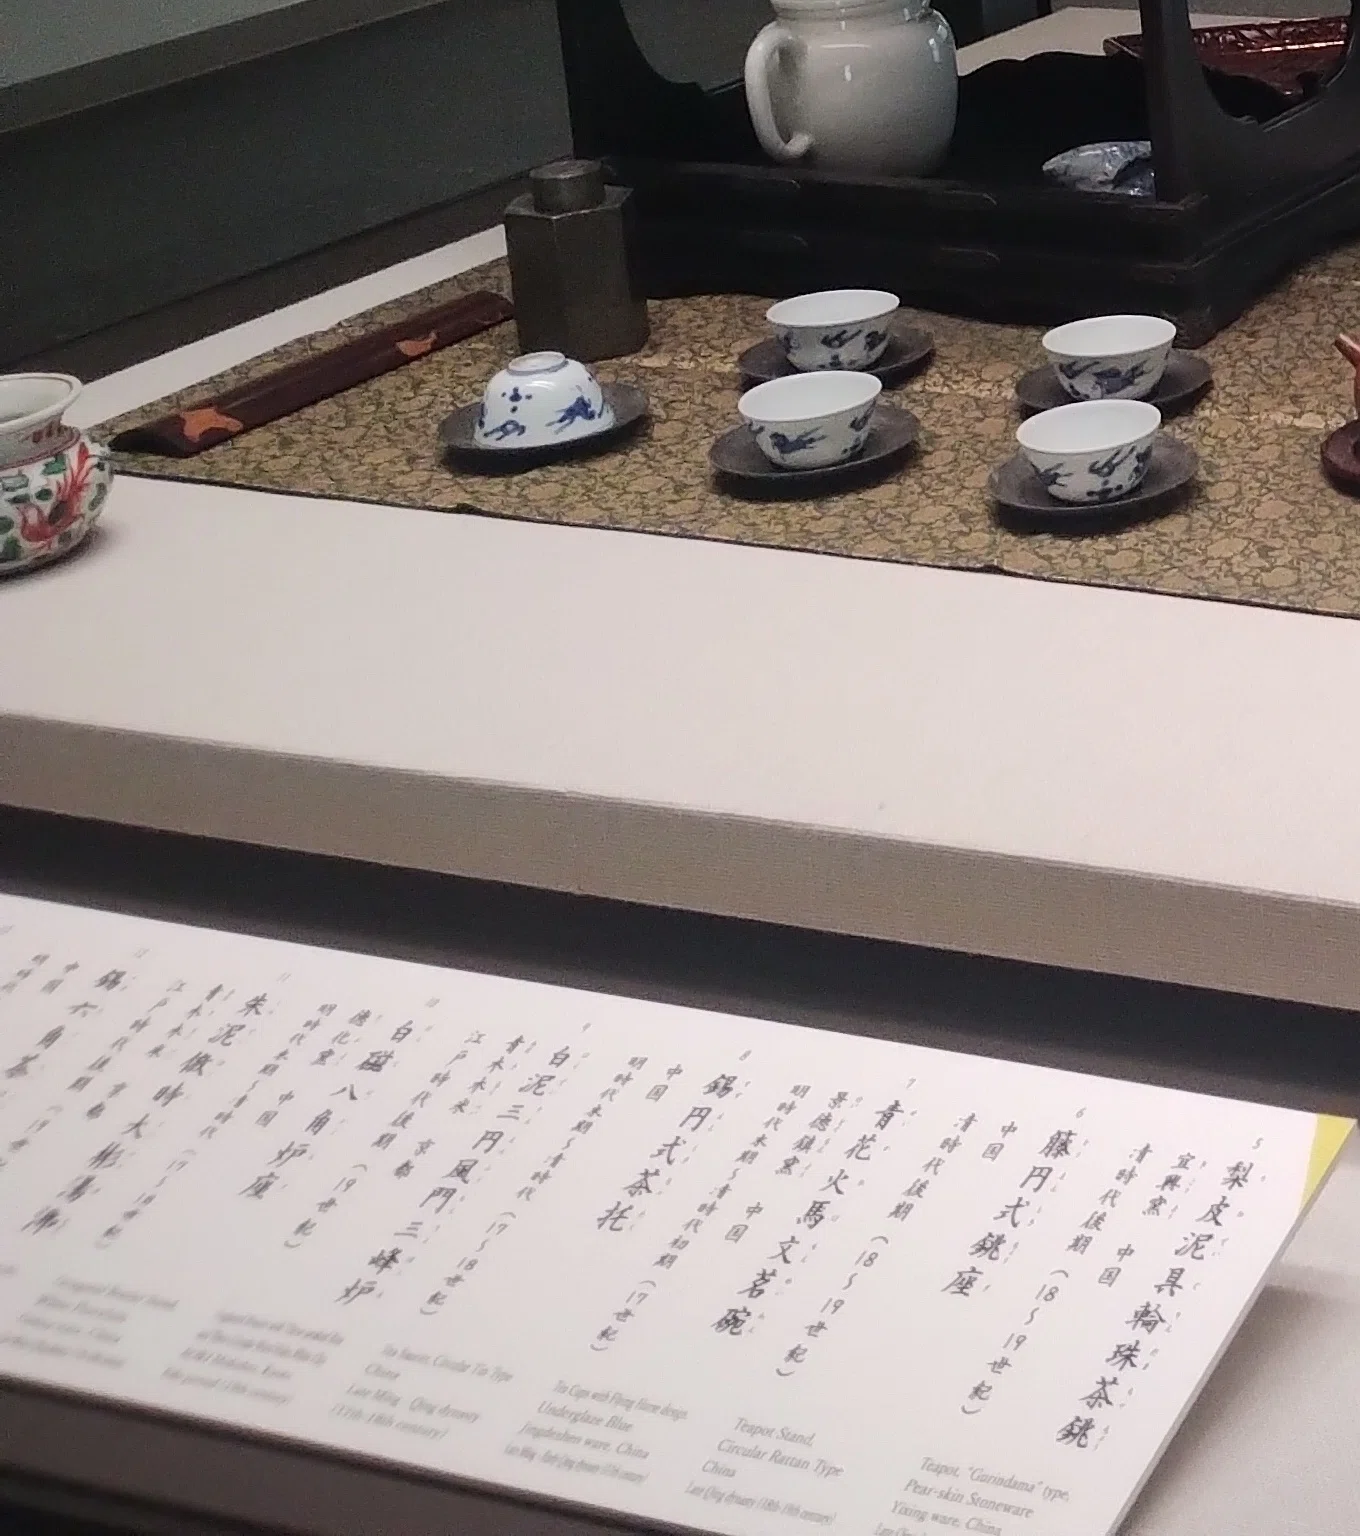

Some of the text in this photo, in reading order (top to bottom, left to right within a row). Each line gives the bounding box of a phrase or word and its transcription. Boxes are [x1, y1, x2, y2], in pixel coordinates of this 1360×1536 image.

[645, 1064, 683, 1102] 中国
[1076, 1107, 1087, 1119] 6
[597, 1073, 738, 1232] 錫円式茶托
[981, 1120, 1018, 1161] 中国
[1252, 1137, 1264, 1150] 5
[711, 1099, 904, 1336] 青花火馬文茗碗
[724, 1202, 763, 1243] 中国
[1098, 1244, 1135, 1287] 中国
[604, 1415, 634, 1433] Blue
[733, 1417, 776, 1438] Teapot
[615, 1441, 650, 1459] China
[701, 1459, 737, 1478] China
[717, 1438, 844, 1480] Circular Rattan Type
[904, 1478, 1035, 1520] Pear-skin Stoneware
